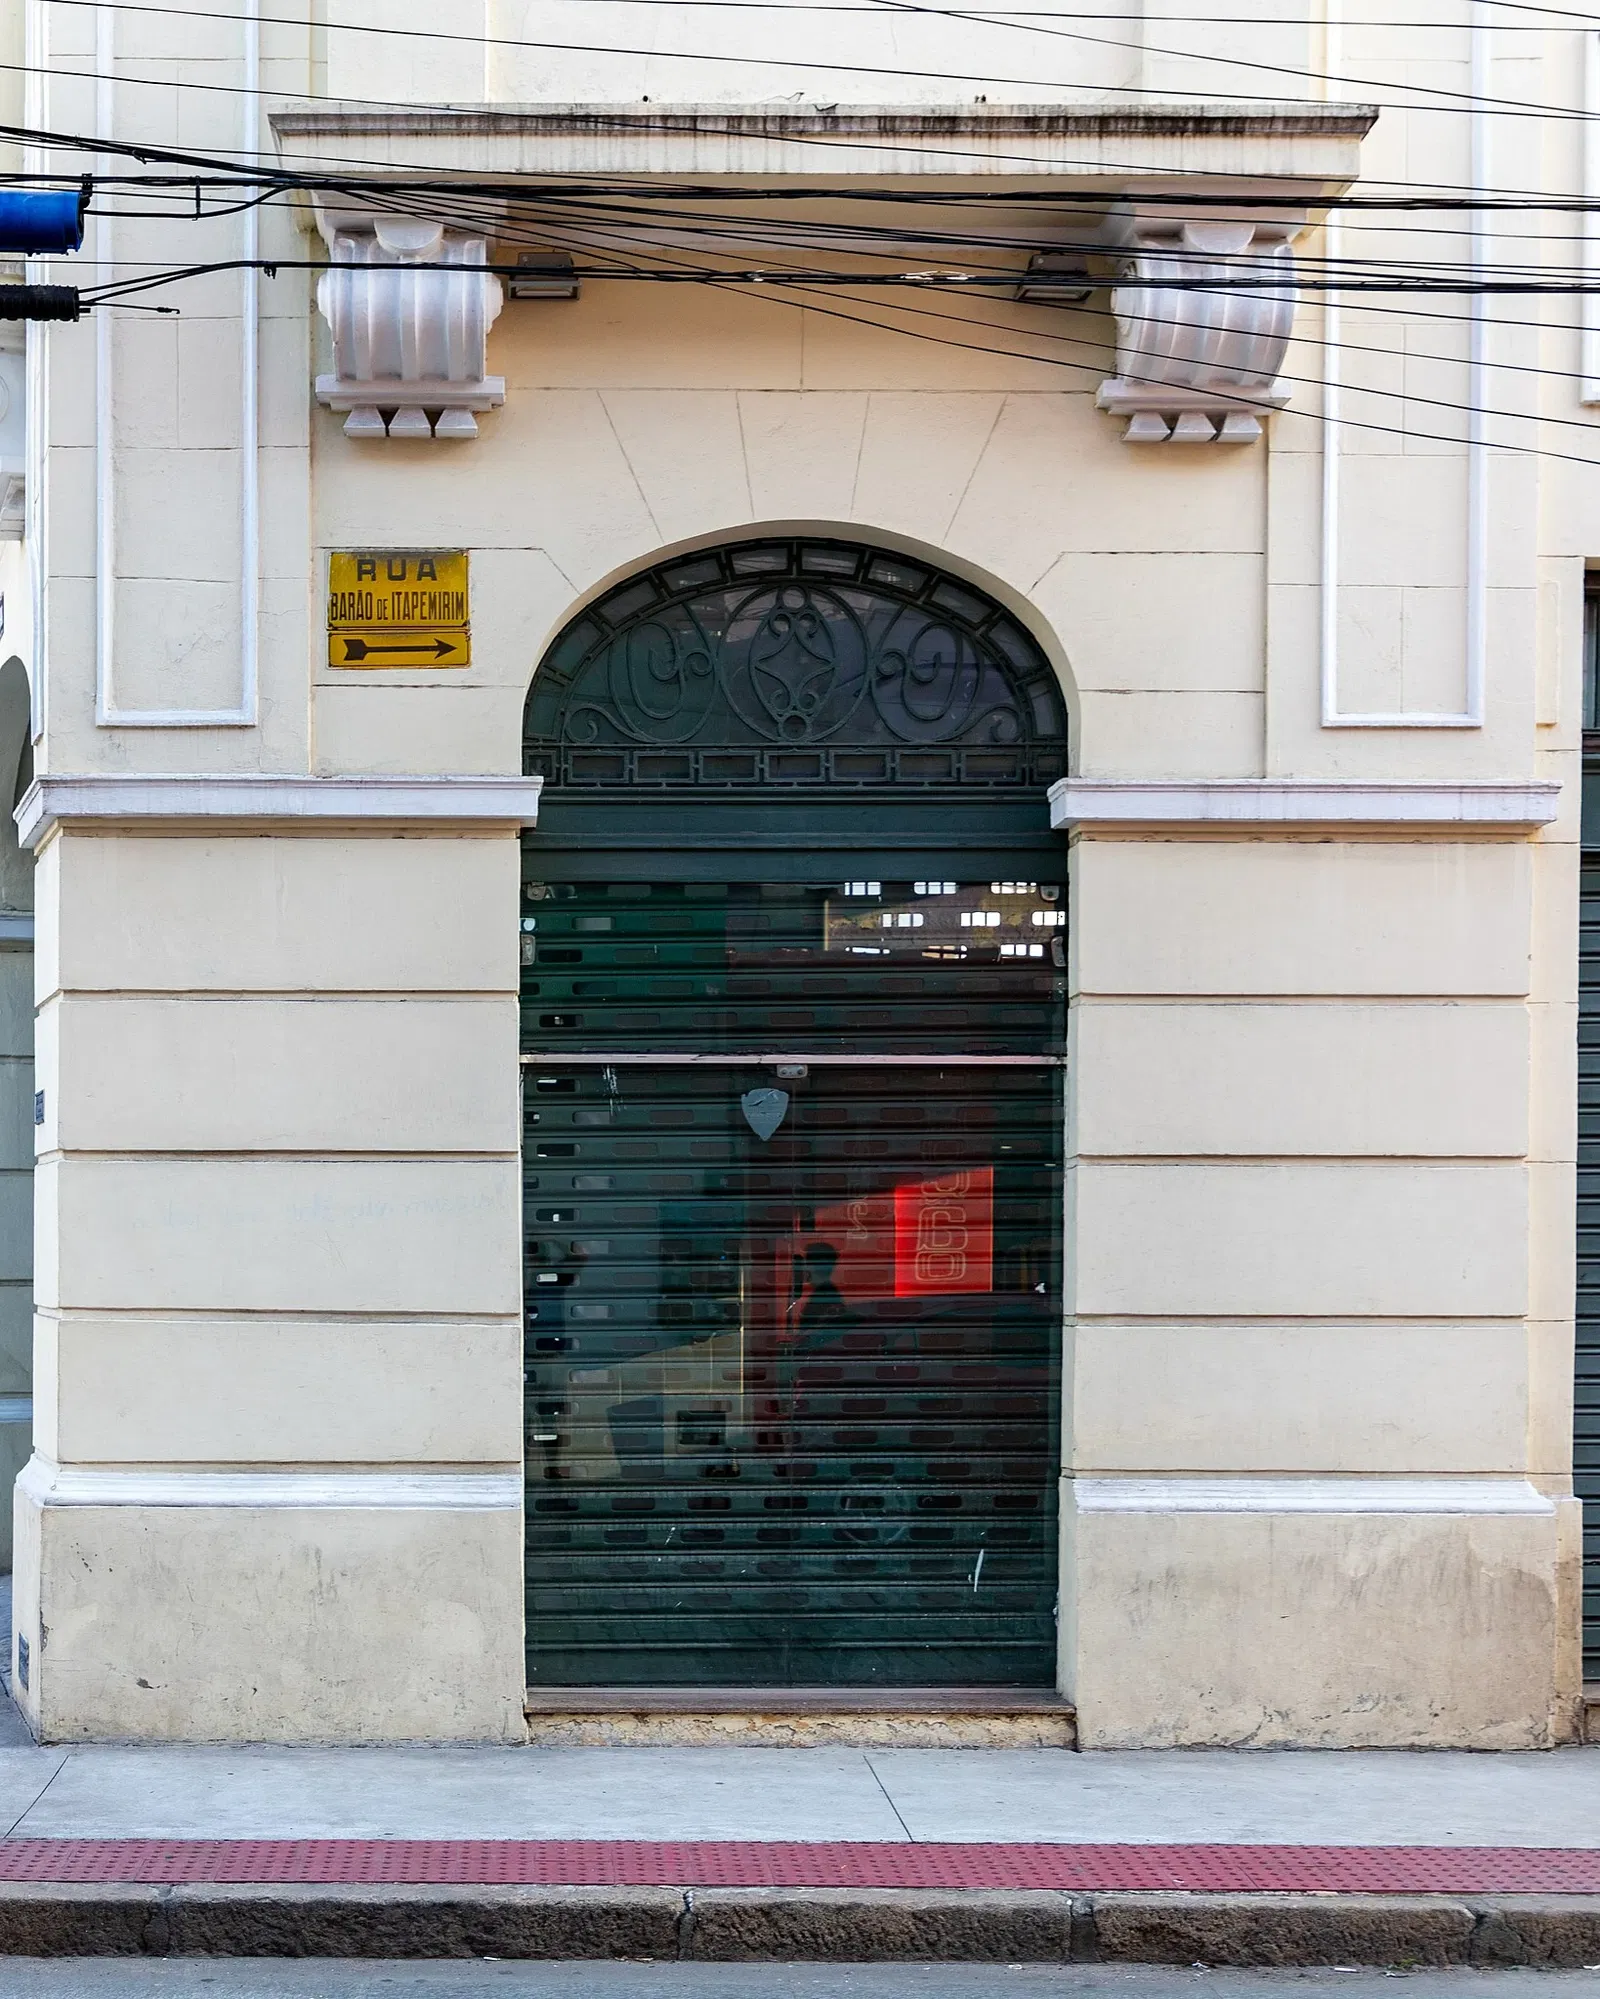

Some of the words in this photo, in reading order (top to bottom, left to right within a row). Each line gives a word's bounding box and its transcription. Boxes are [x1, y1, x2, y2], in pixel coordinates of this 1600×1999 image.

[357, 558, 437, 582] RUA
[330, 590, 373, 621] BARÃO
[376, 598, 388, 621] DE
[391, 591, 464, 621] ITAPEMIRIM
